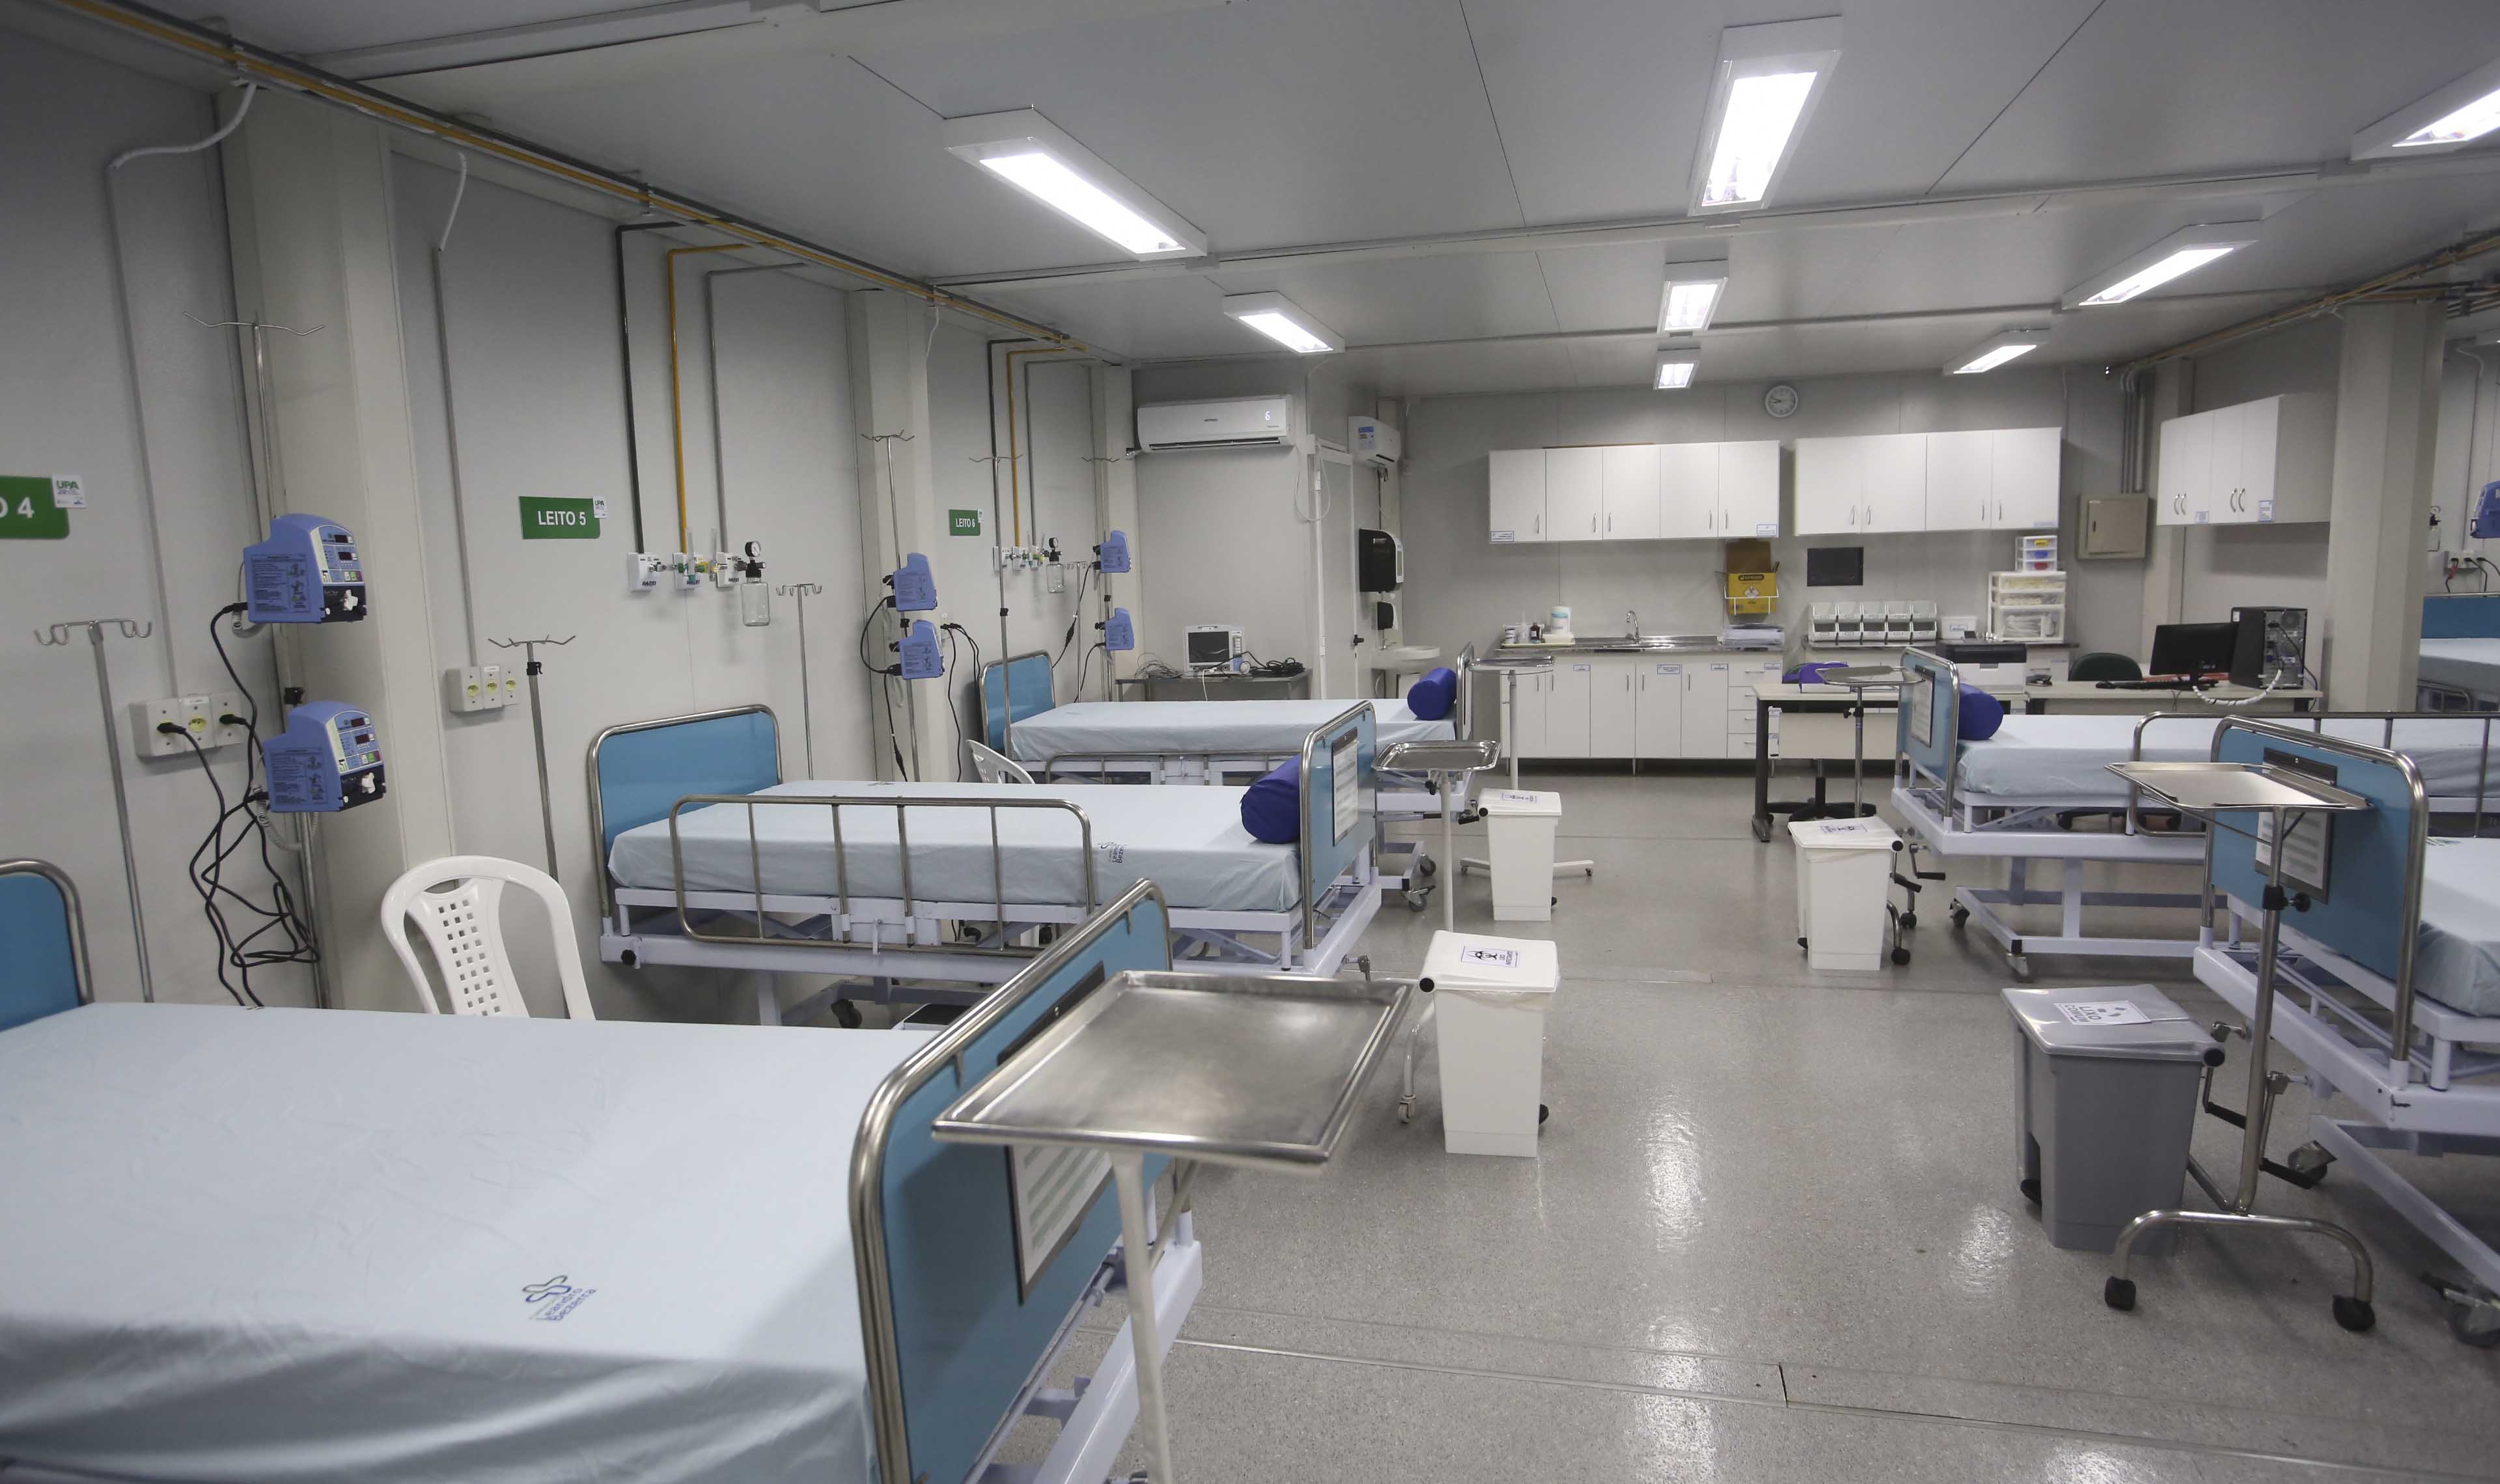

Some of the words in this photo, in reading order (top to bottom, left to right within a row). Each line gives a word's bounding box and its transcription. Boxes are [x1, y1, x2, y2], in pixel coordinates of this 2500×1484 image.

[56, 480, 79, 489] UPA
[17, 497, 35, 518] 4
[538, 511, 576, 525] LEITO
[579, 512, 586, 525] 5
[956, 518, 971, 527] LEITO
[972, 518, 975, 527] 6
[2079, 1006, 2102, 1020] LIXO
